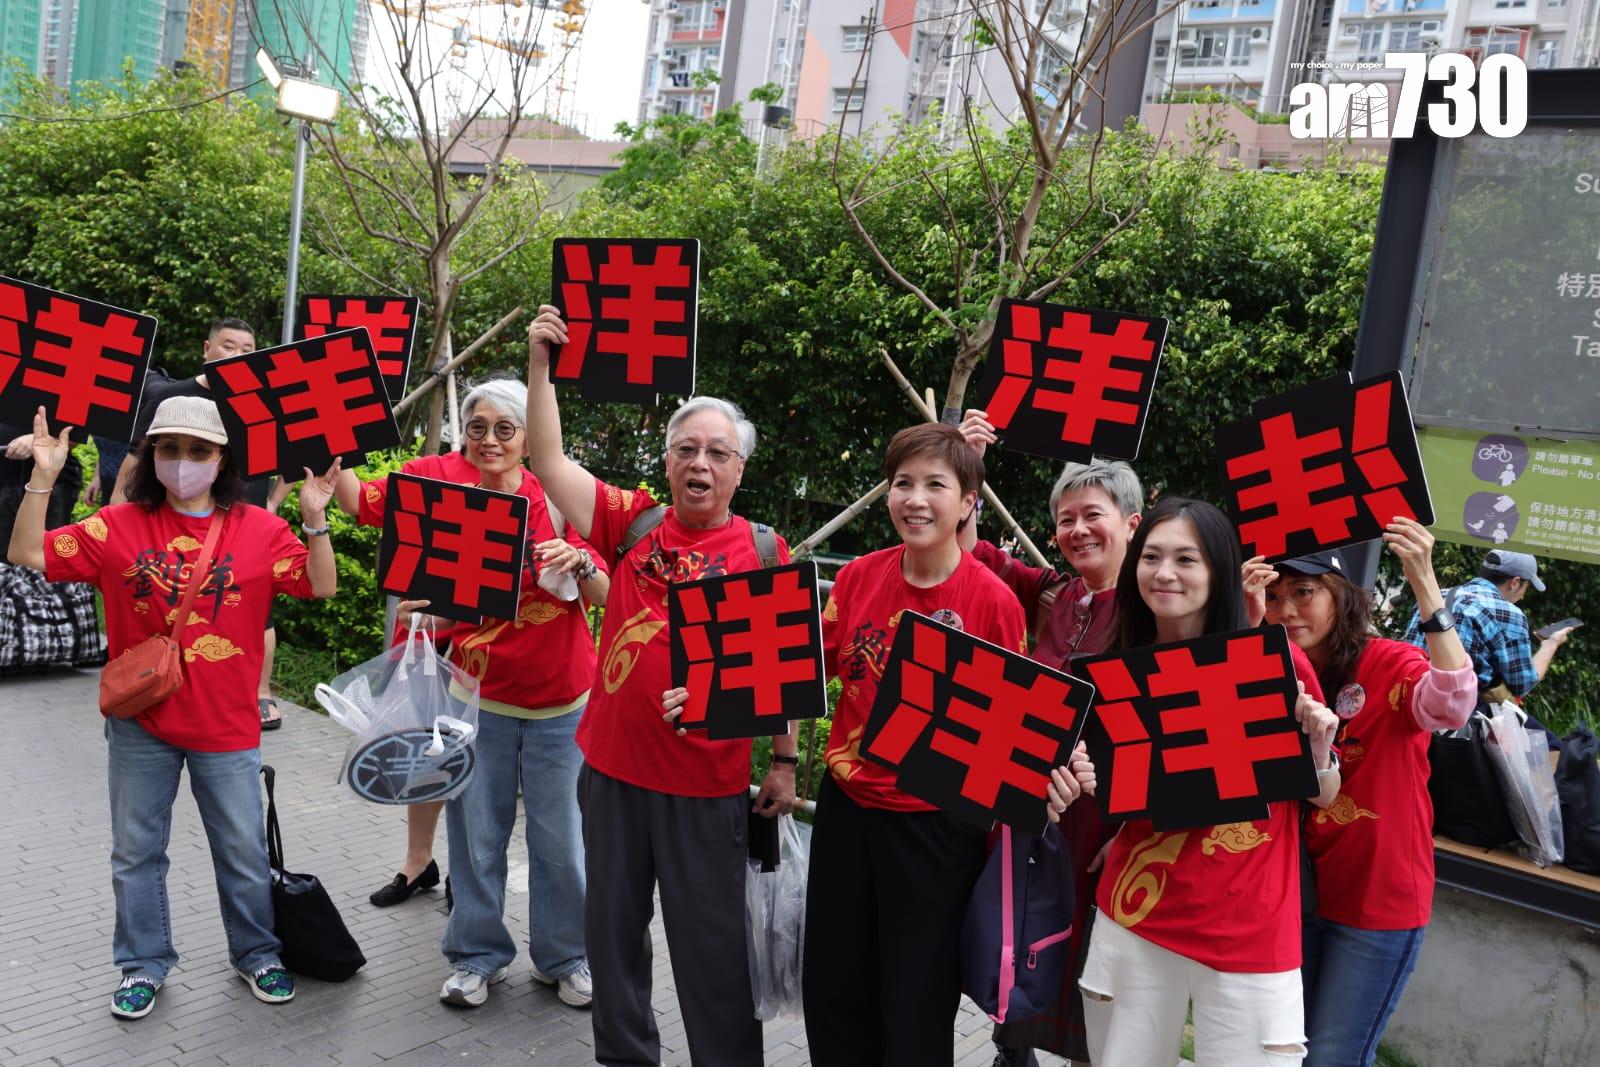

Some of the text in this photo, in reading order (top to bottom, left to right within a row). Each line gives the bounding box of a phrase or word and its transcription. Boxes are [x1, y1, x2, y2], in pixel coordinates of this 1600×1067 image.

[0, 283, 145, 426] 洋
[556, 245, 690, 385] 洋
[985, 304, 1155, 445] 洋
[216, 337, 387, 475] 洋
[1226, 381, 1418, 559] 洋
[1532, 463, 1568, 477] Please
[1578, 469, 1594, 480] No
[383, 480, 520, 608] 洋
[677, 571, 816, 723] 洋
[868, 622, 1076, 809] 洋
[1087, 636, 1302, 814] 洋
